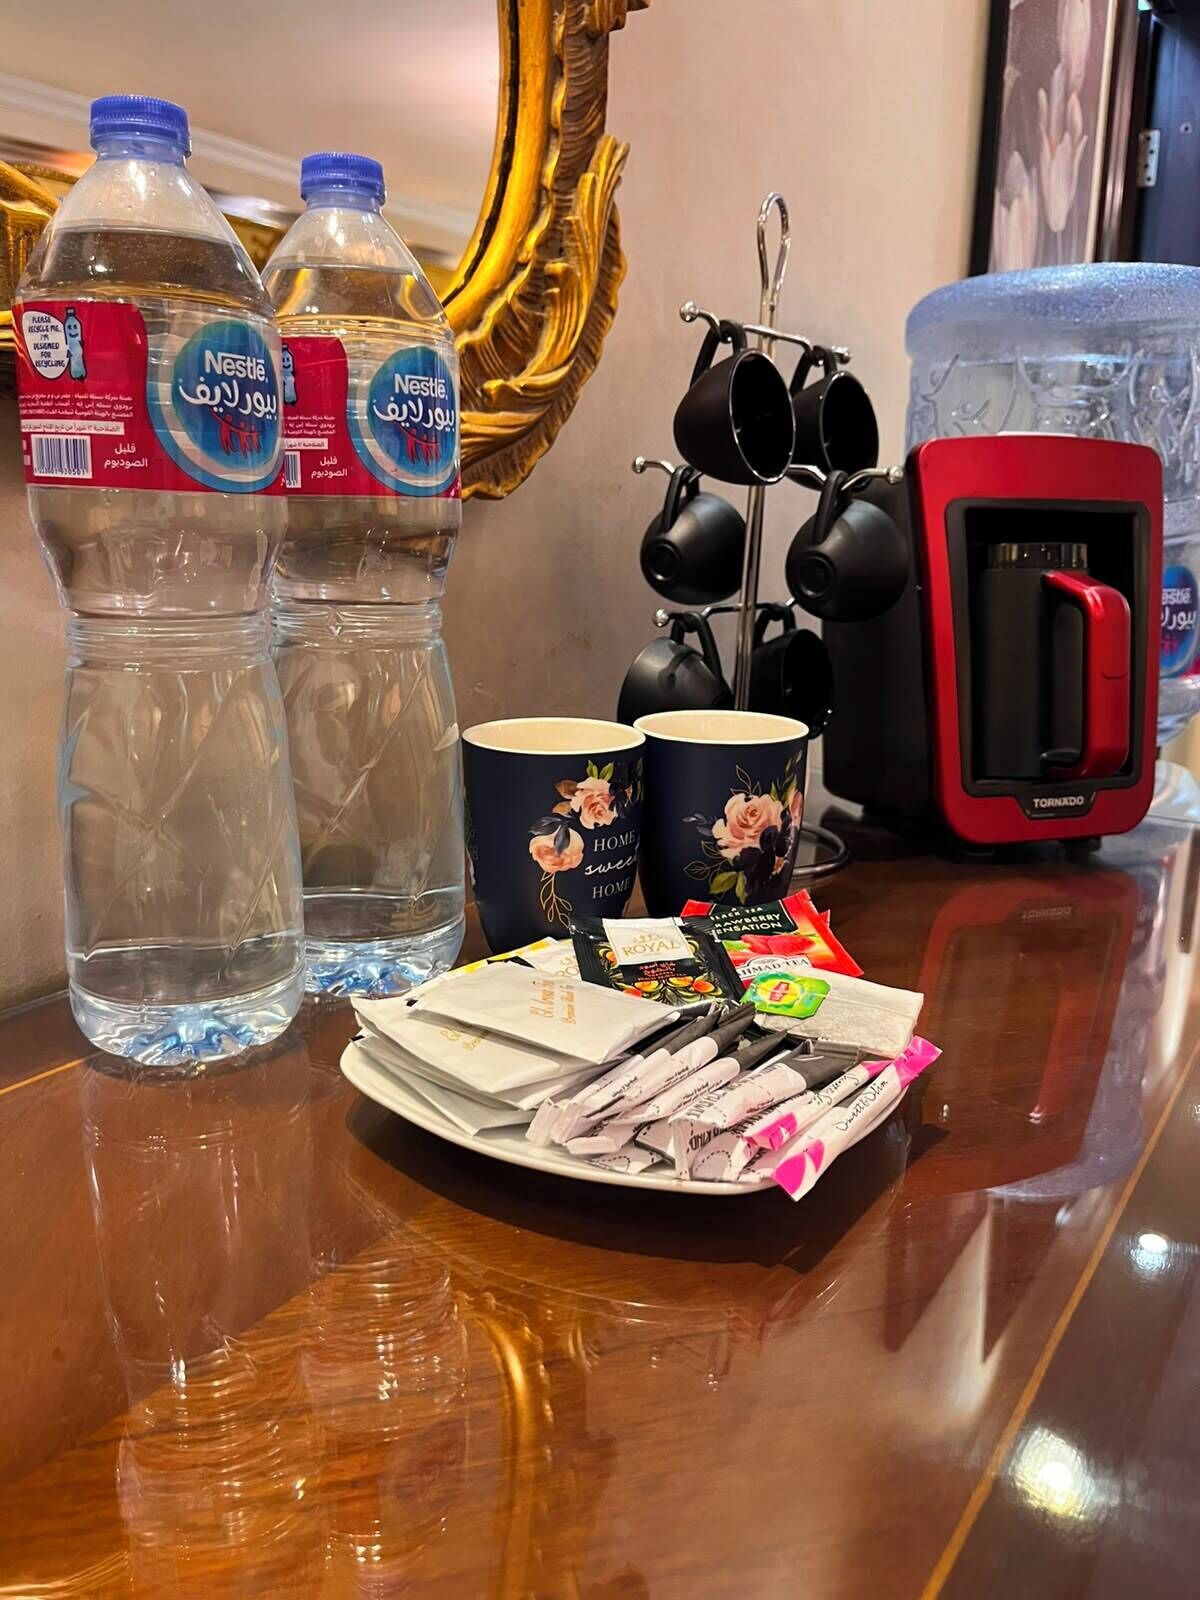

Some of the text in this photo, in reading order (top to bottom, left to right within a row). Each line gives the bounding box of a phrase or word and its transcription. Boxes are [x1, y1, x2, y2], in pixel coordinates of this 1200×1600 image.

[178, 376, 278, 420] بيور لايف
[372, 396, 455, 432] بيور لايف
[103, 457, 148, 469] الصوديوم
[1032, 795, 1085, 808] TORNADO
[593, 829, 636, 853] HOME
[716, 921, 783, 935] ENSATION
[622, 940, 681, 956] ROYAL
[740, 958, 810, 976] HMAD TEA
